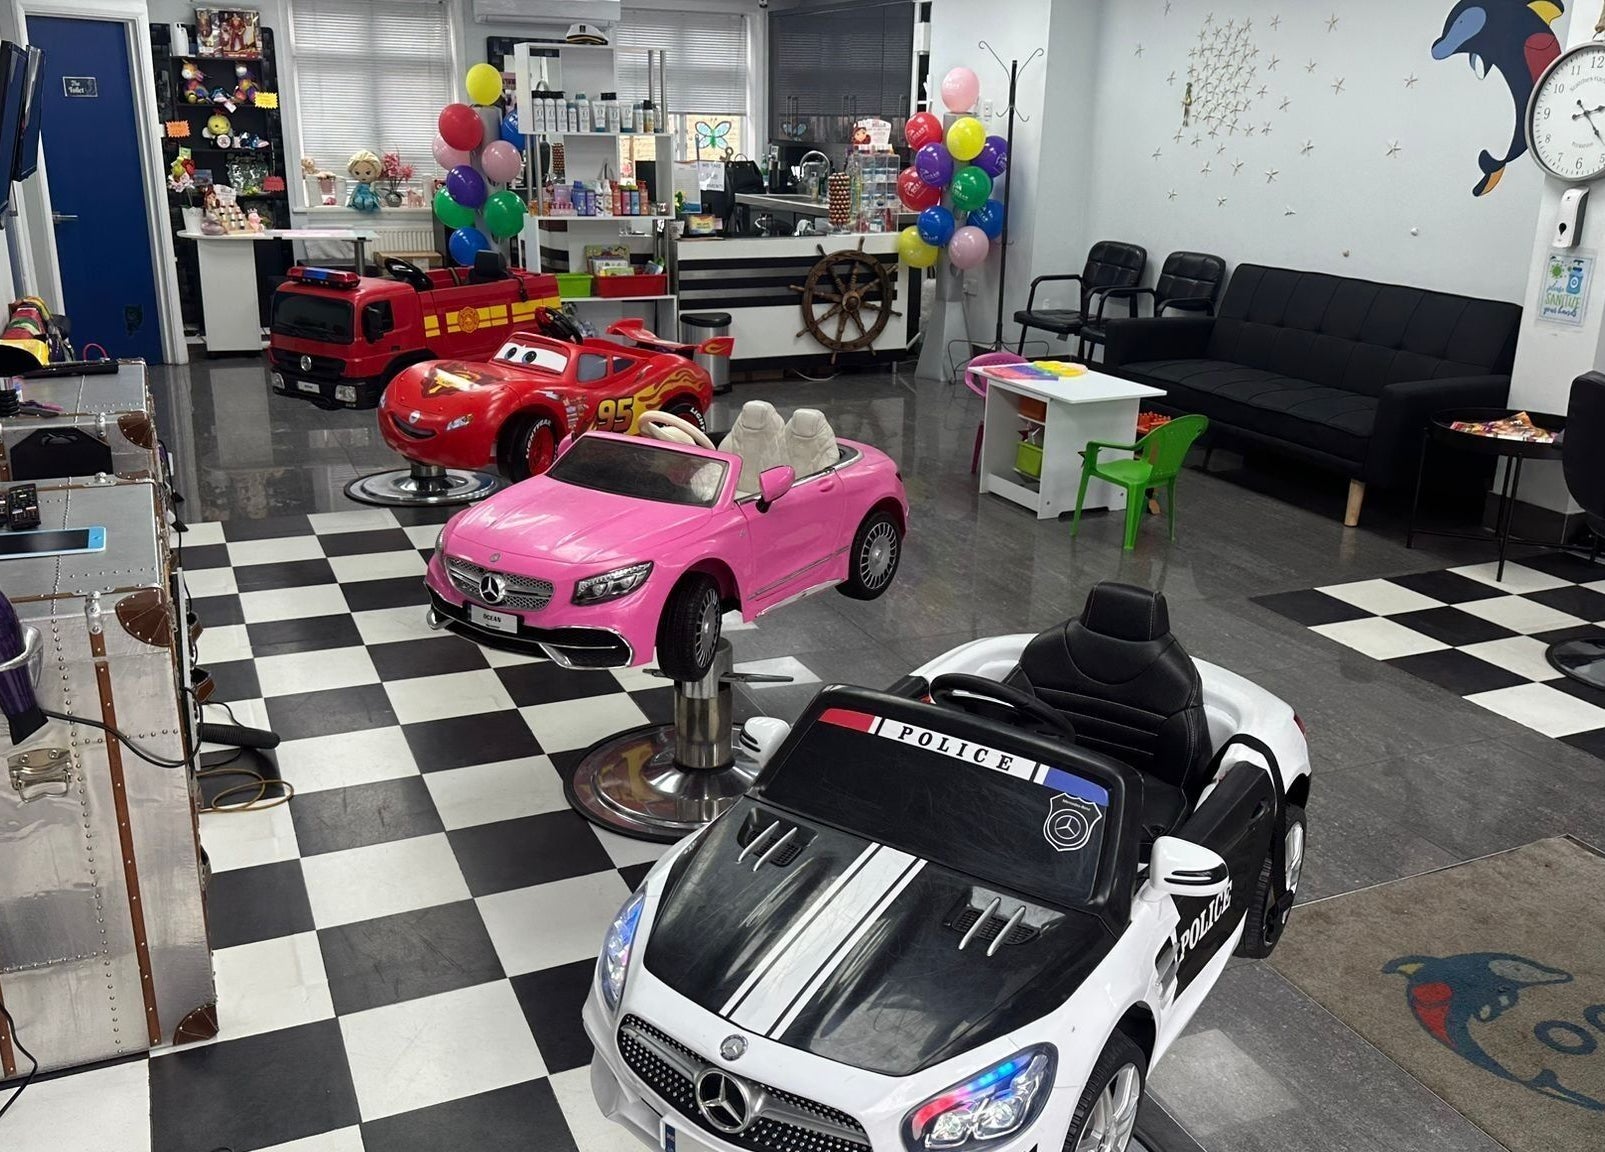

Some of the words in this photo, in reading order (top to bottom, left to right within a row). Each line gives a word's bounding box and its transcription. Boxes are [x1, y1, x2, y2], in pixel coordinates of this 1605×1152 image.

[1591, 55, 1604, 69] 12
[1571, 65, 1581, 75] 11
[1553, 83, 1565, 94] 10
[1543, 107, 1551, 120] 9
[1544, 133, 1552, 144] 8
[1557, 152, 1565, 162] 7
[1575, 157, 1583, 169] 6
[597, 396, 634, 432] 95
[525, 419, 551, 459] LIGHTYEAR
[897, 725, 1015, 772] POLICE
[1178, 880, 1232, 963] POLICE
